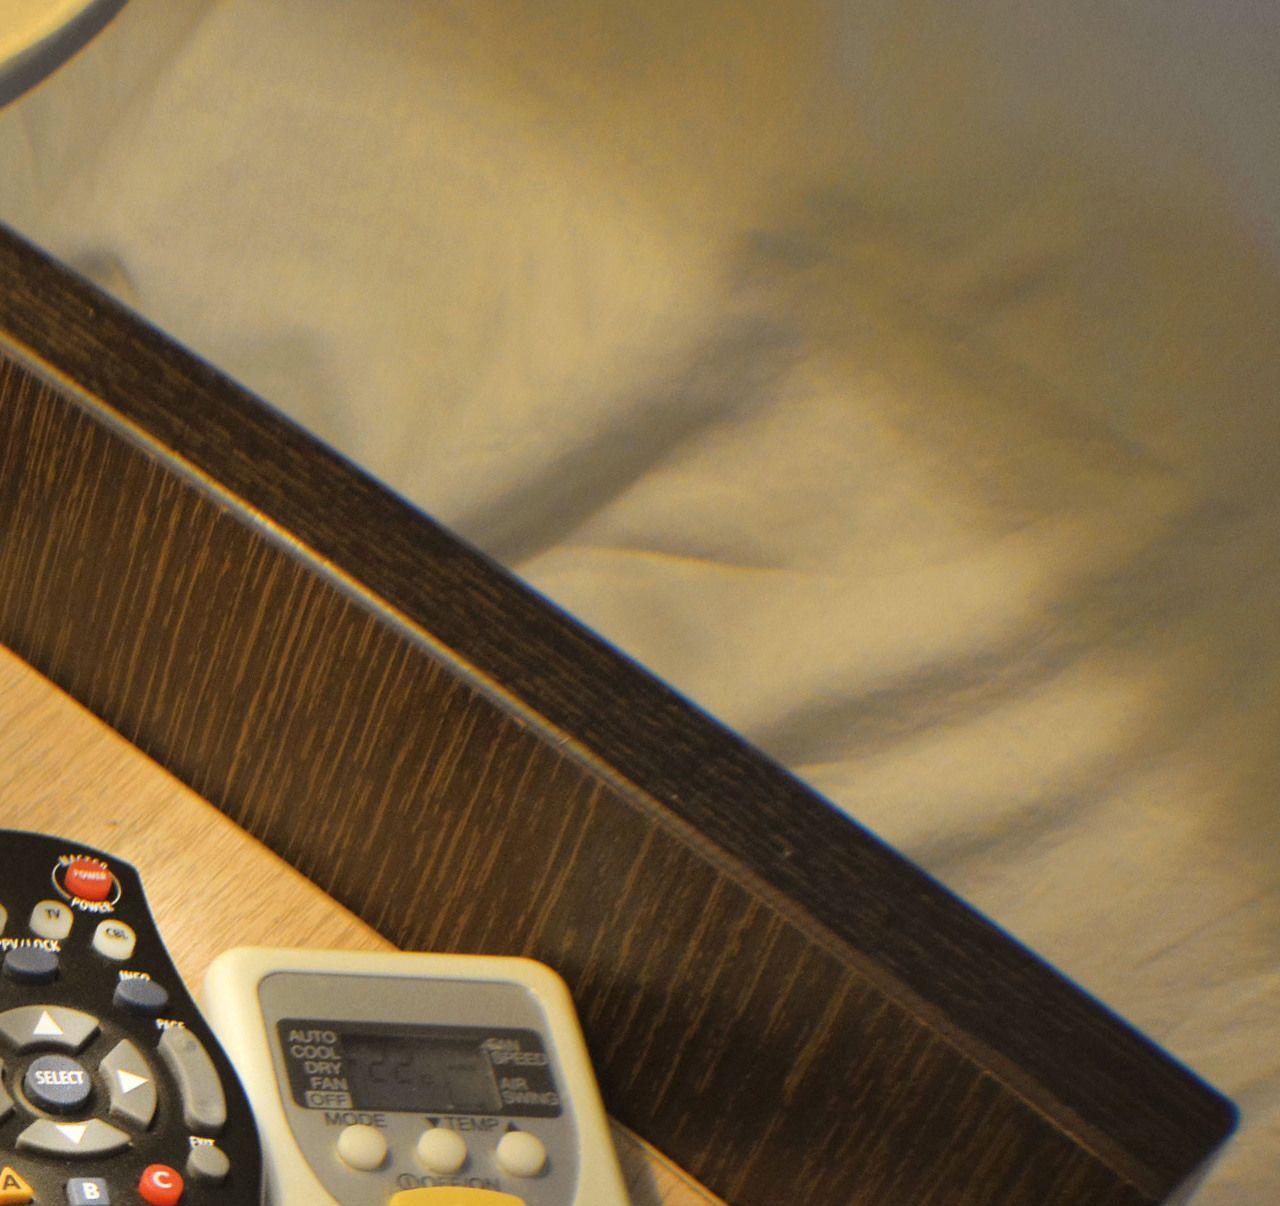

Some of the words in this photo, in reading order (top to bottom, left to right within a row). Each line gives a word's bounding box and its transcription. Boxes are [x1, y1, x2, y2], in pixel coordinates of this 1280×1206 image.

[71, 896, 115, 913] POWER
[45, 908, 61, 919] TV
[290, 1030, 336, 1046] AUTO
[291, 1044, 341, 1060] COOL
[305, 1060, 342, 1075] DRY
[35, 1070, 84, 1086] SELECT
[310, 1075, 348, 1091] FAN
[310, 1091, 348, 1107] OFF
[325, 1111, 387, 1128] MODE
[446, 1116, 500, 1132] TEMP
[2, 1175, 22, 1191] A
[152, 1171, 173, 1188] C
[82, 1182, 100, 1200] B
